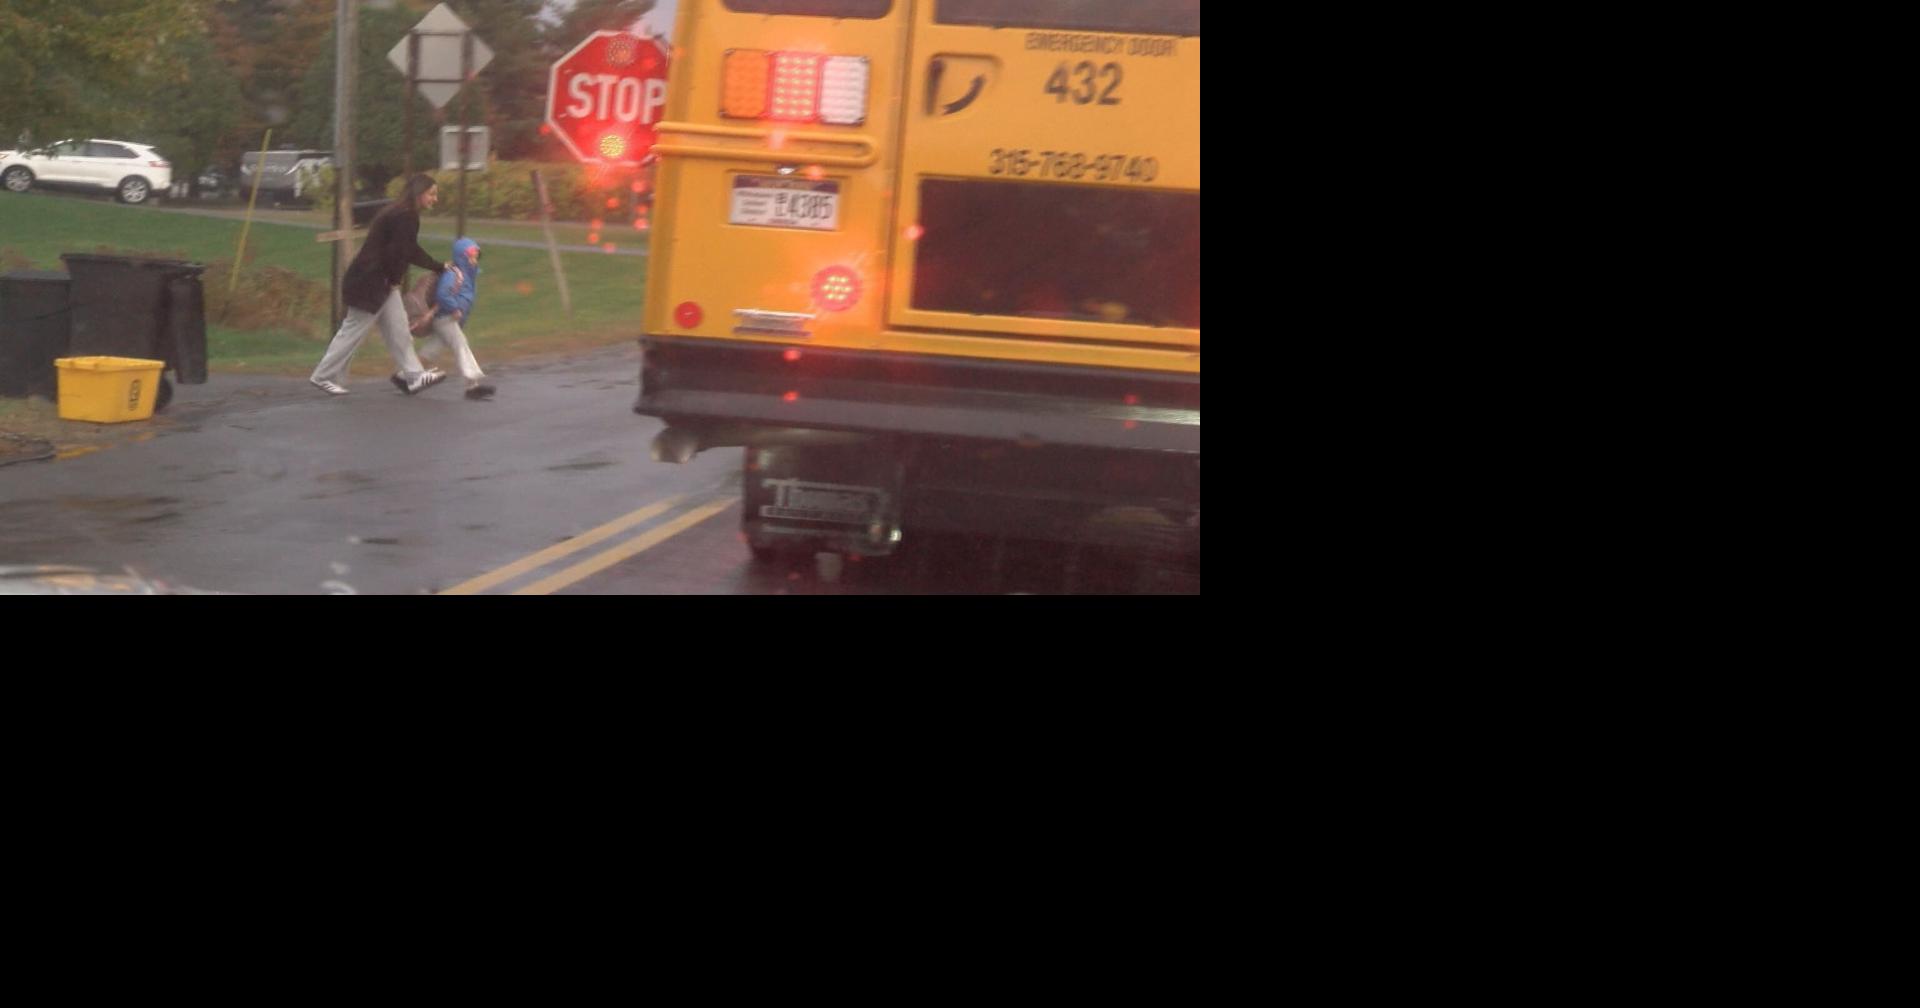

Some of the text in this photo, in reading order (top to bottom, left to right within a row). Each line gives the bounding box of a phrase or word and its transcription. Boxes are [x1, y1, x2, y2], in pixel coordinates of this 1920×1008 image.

[566, 72, 668, 125] STOP
[1044, 59, 1123, 105] 432
[989, 148, 1158, 183] 315-768-9740
